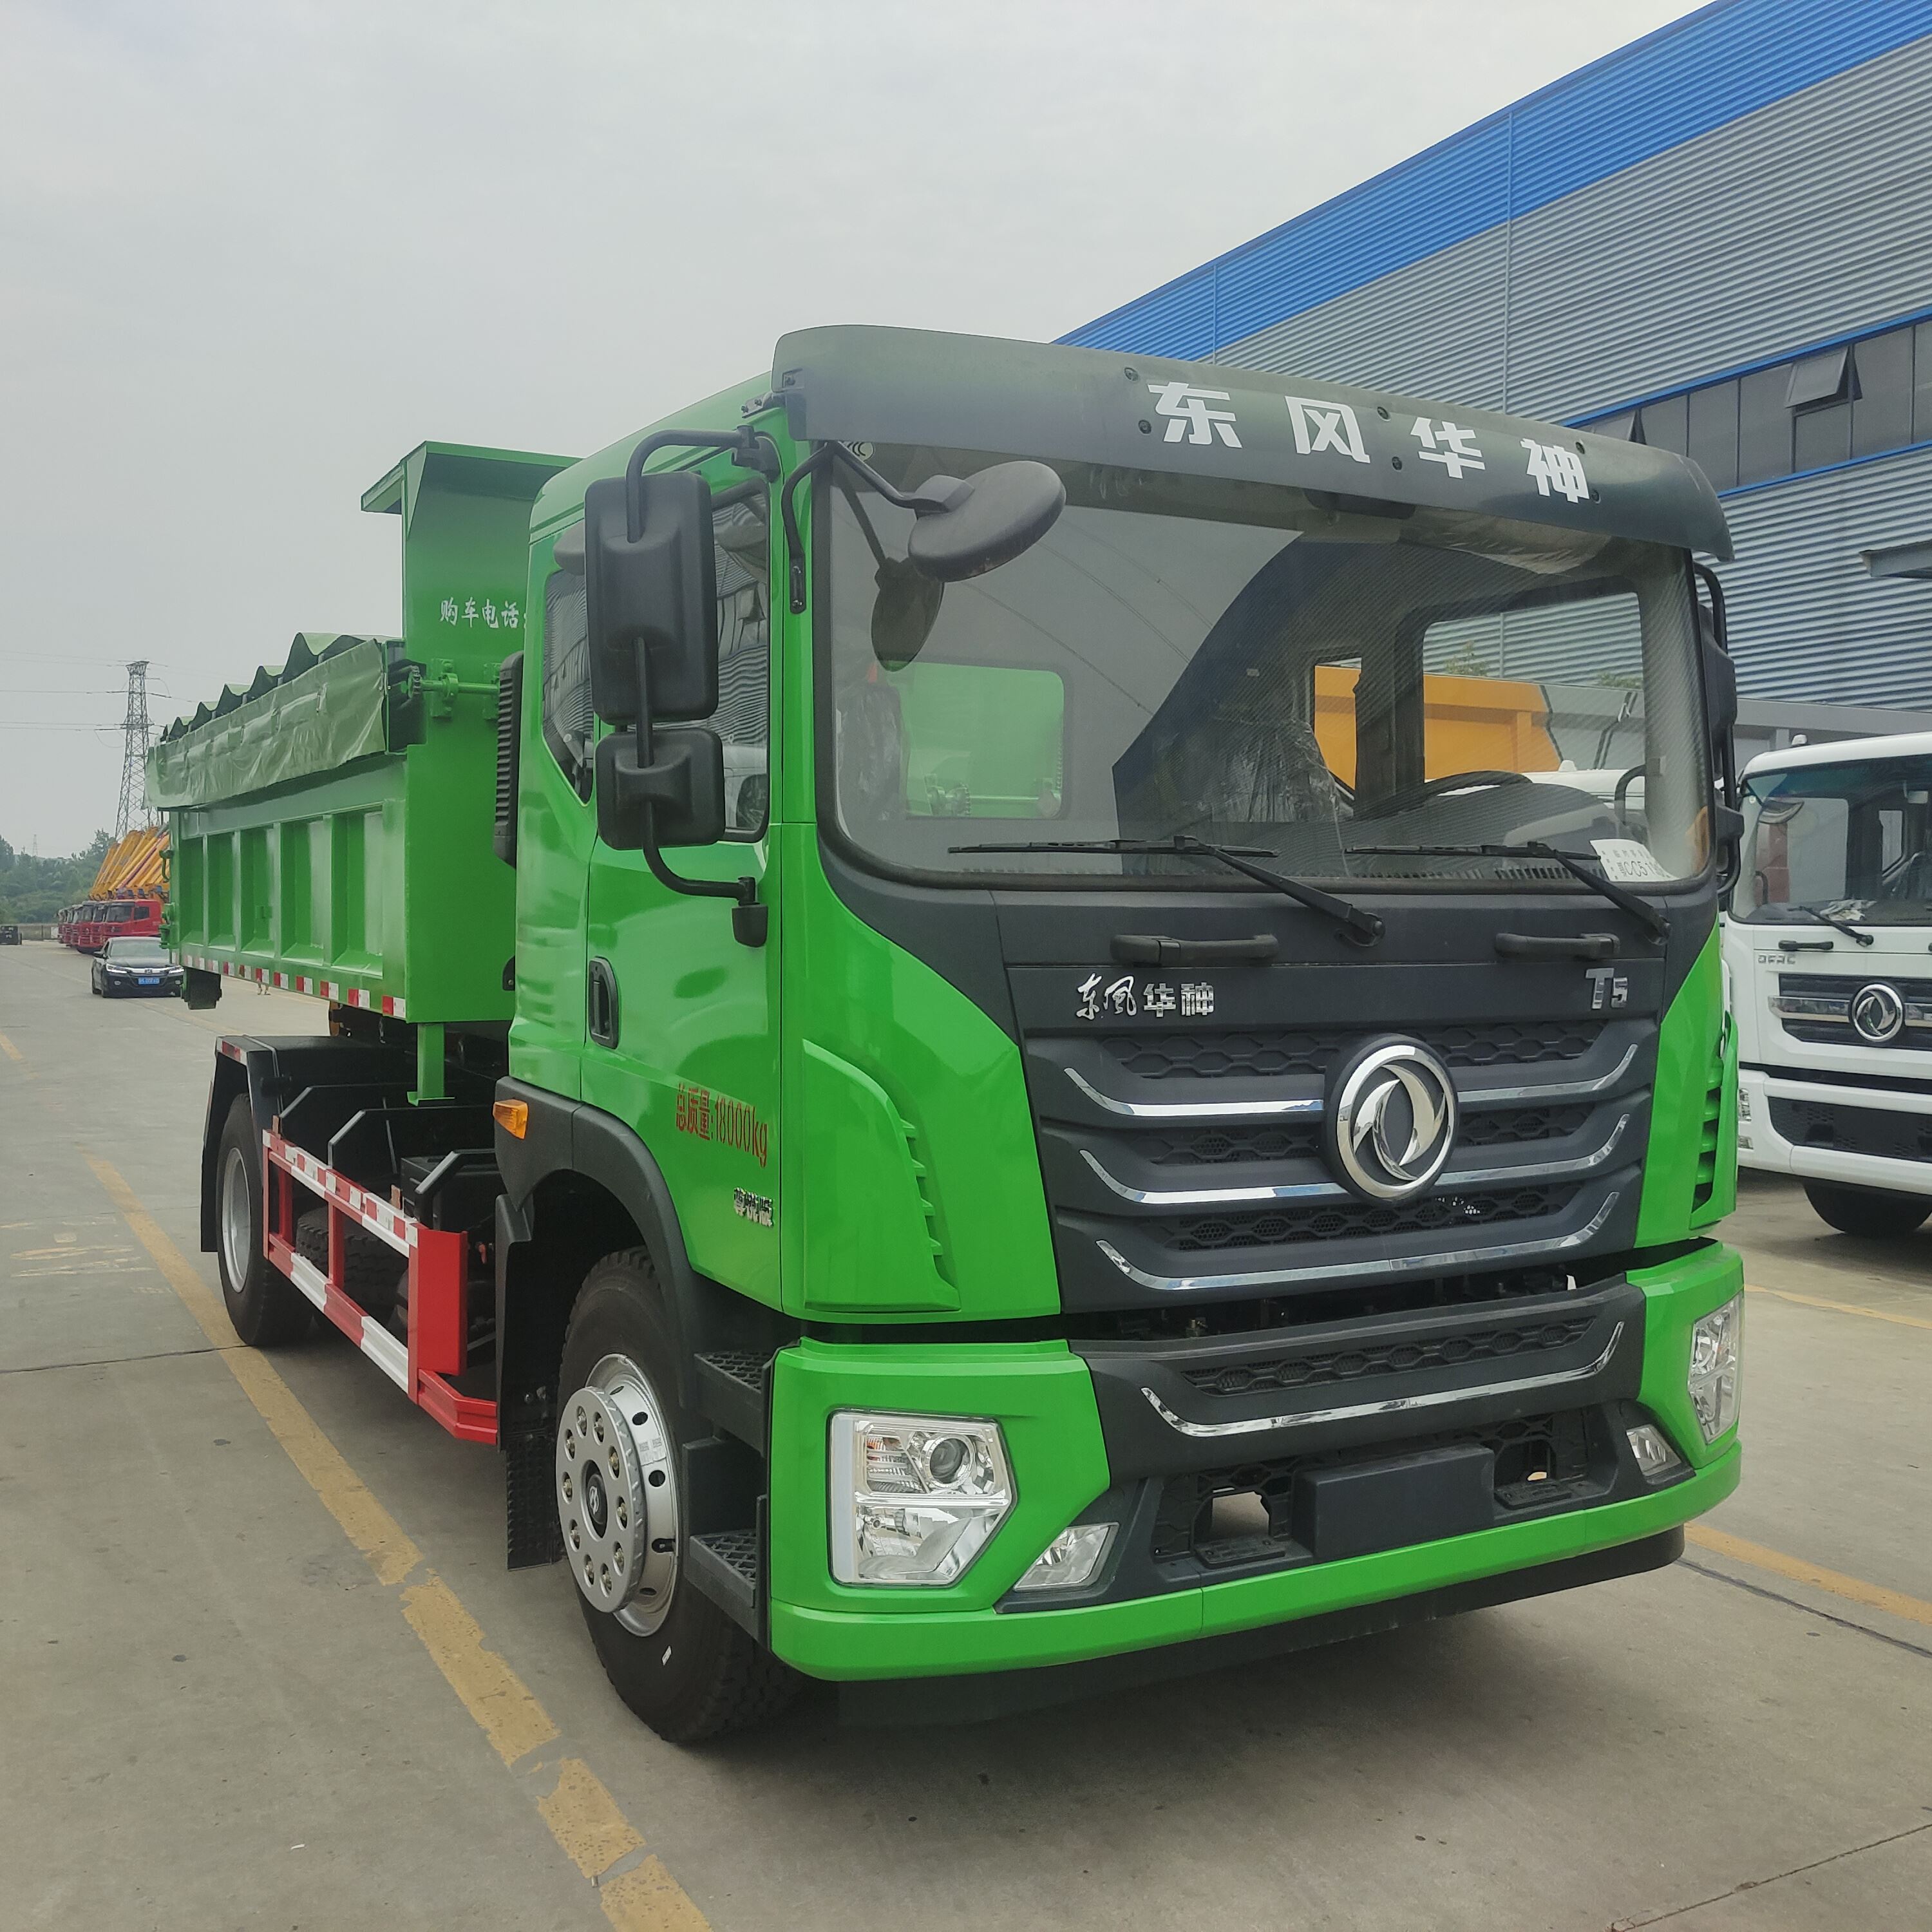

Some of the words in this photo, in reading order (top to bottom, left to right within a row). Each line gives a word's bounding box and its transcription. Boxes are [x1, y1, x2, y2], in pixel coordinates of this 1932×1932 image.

[1147, 381, 1590, 504] 东风华神
[1586, 967, 1628, 1010] T5
[676, 1083, 768, 1169] 总质量:18000kg
